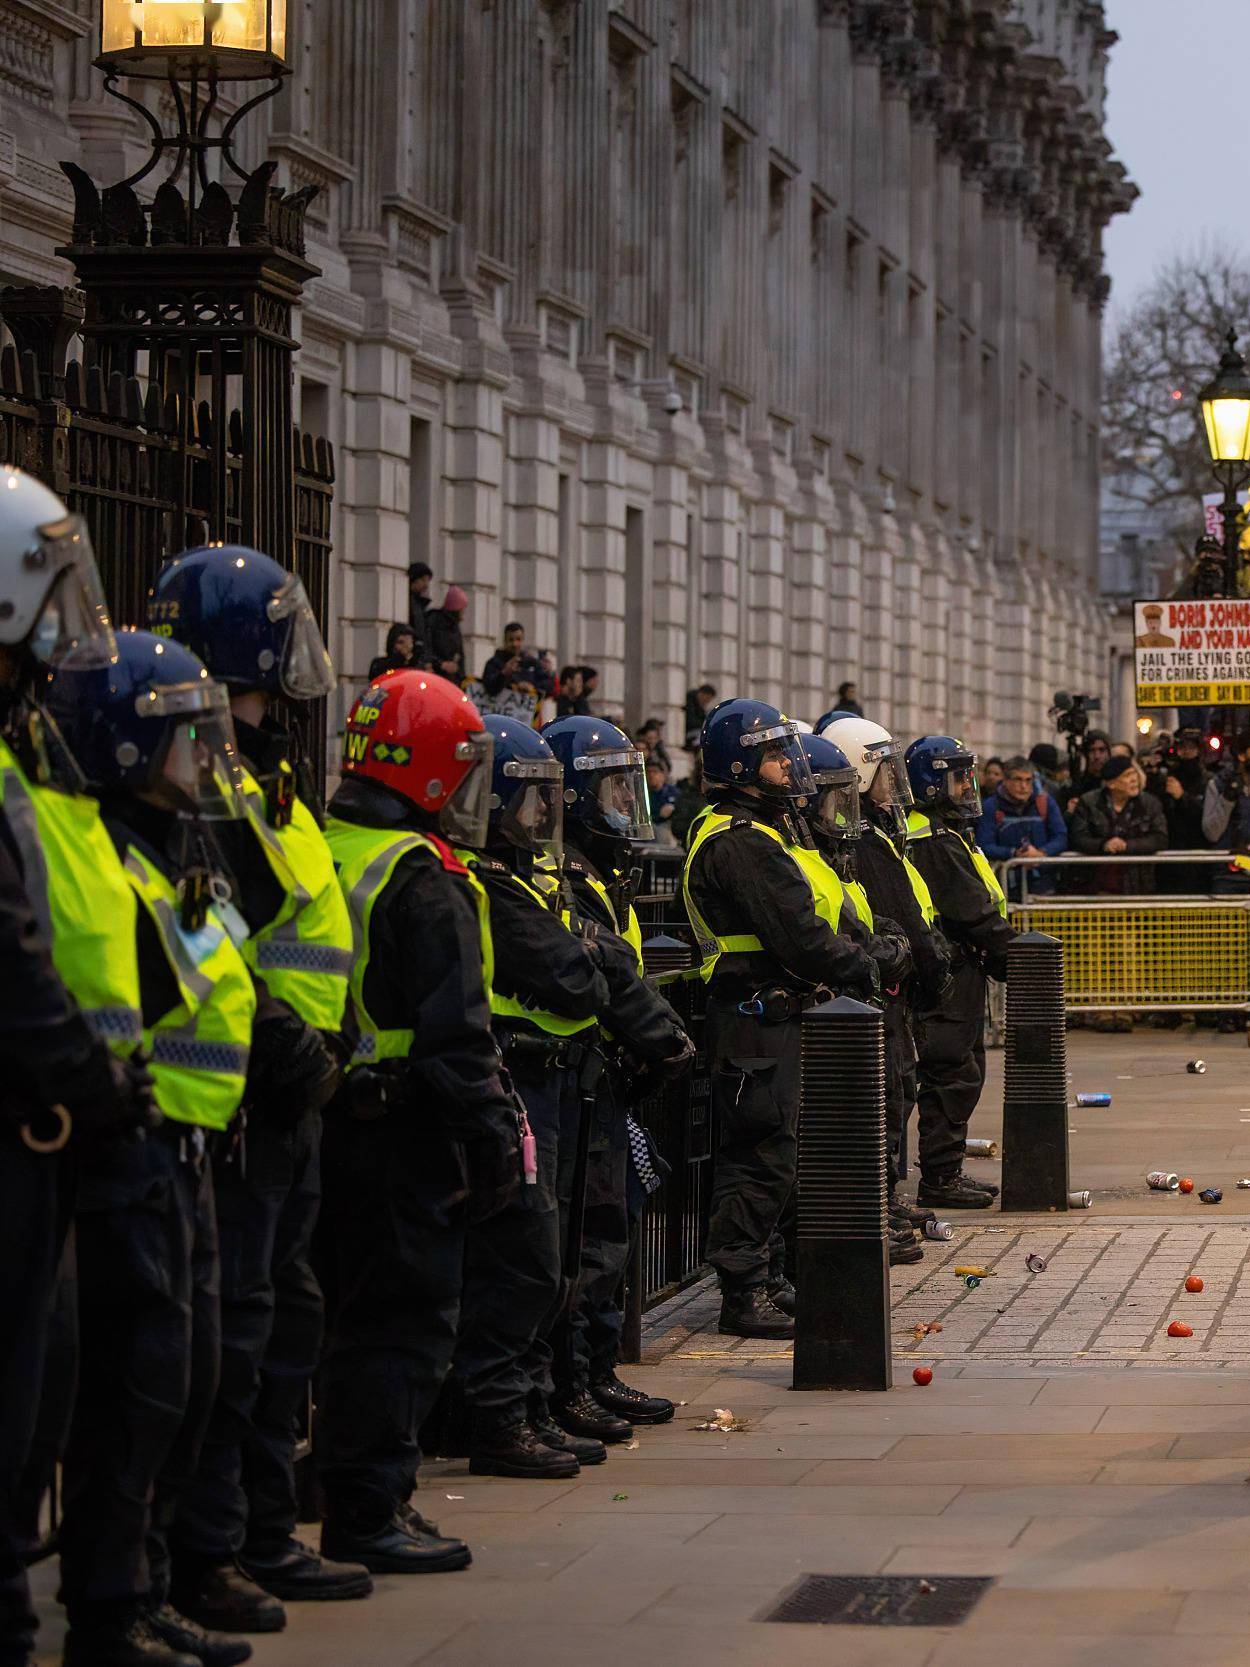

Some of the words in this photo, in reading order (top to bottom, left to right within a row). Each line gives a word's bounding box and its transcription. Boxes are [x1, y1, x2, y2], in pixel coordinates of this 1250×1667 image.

[1168, 604, 1206, 628] BORIS
[1179, 630, 1202, 650] AND
[1204, 629, 1235, 649] YOUR
[1141, 653, 1166, 666] JAIL
[1170, 652, 1193, 665] THE
[1197, 651, 1232, 665] LYING
[1141, 667, 1162, 682] FOR
[1166, 667, 1208, 681] CRIMES
[1138, 686, 1157, 702] SAVE
[1158, 686, 1172, 702] THE
[1216, 685, 1231, 701] SAY
[1232, 685, 1242, 701] NO
[354, 705, 380, 725] MP
